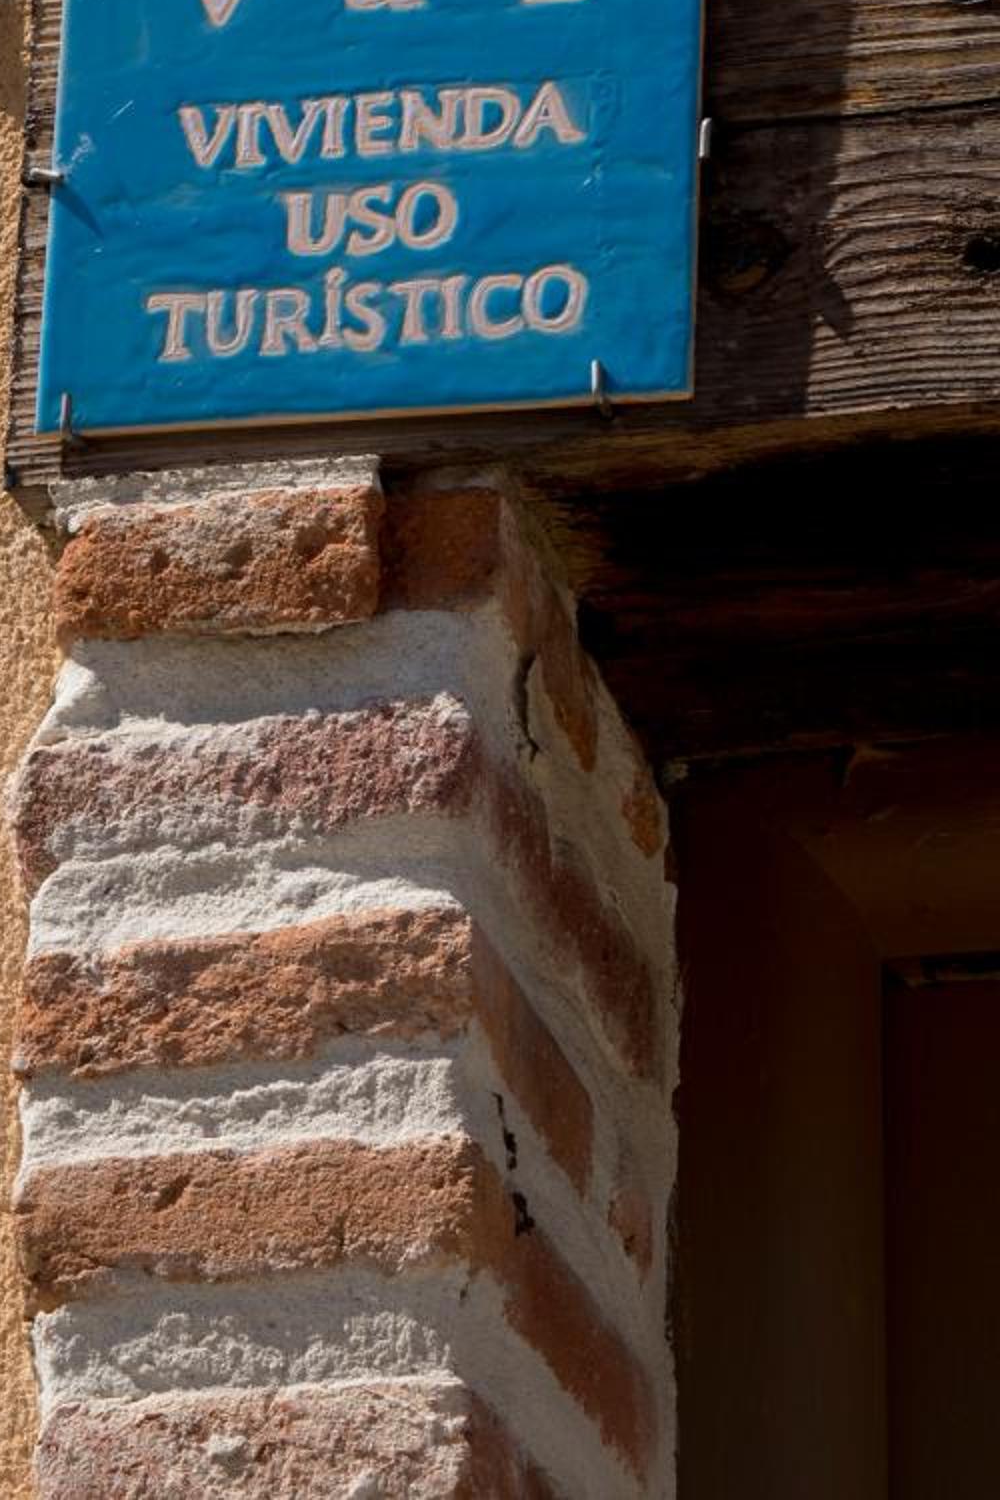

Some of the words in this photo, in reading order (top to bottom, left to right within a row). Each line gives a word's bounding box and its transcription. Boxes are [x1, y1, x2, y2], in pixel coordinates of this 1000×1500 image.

[179, 82, 585, 169] VIVIENDA
[284, 181, 459, 256] USO
[147, 264, 588, 363] TURÍSTICO
